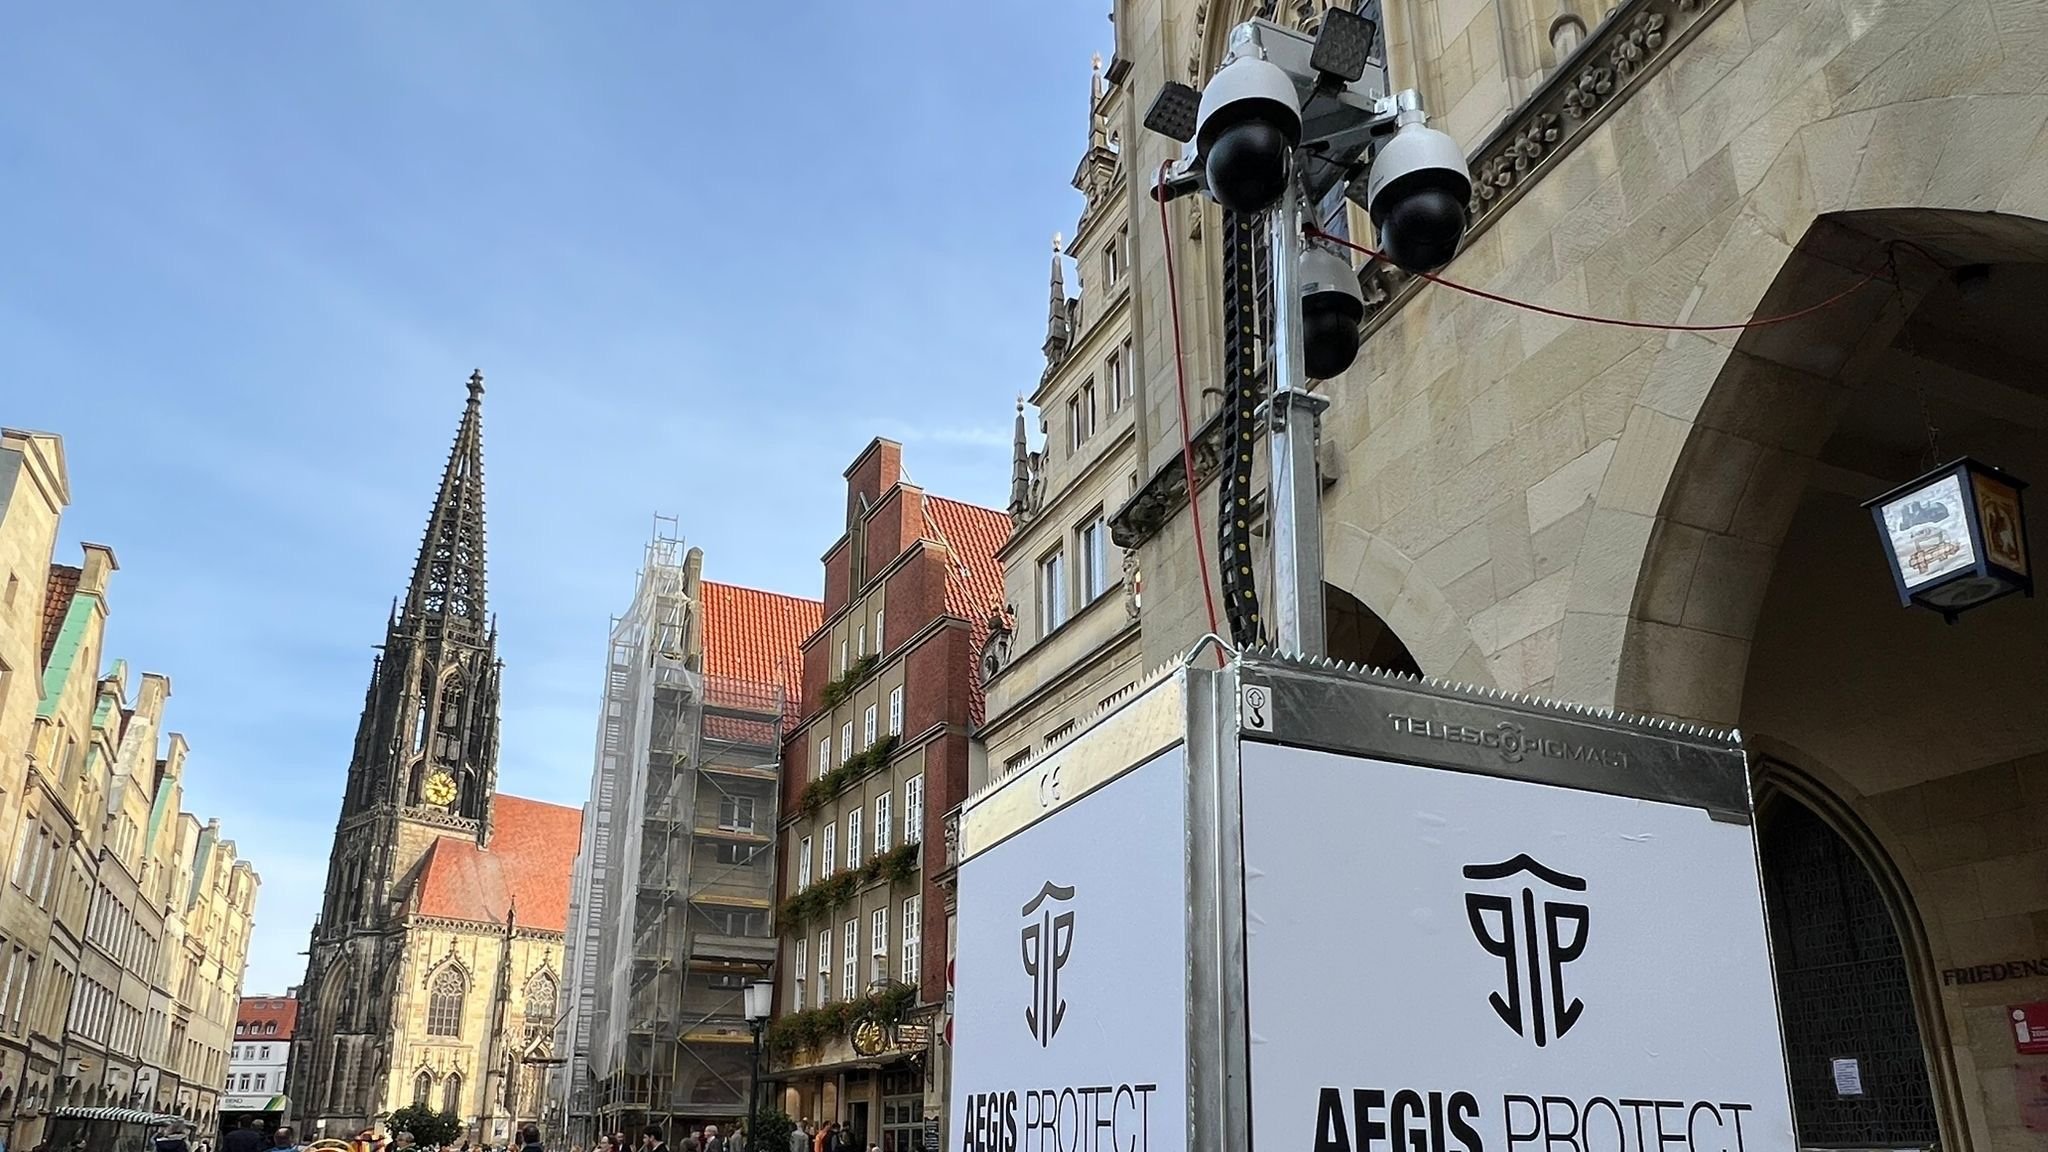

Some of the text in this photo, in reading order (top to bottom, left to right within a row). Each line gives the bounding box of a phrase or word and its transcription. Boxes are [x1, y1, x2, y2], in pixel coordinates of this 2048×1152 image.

[1387, 713, 1632, 768] TELESCOPICMAST
[963, 1091, 1018, 1152] AEGIS
[1026, 1084, 1157, 1152] PROTECT
[1313, 1087, 1753, 1152] AEGIS PROTECT
